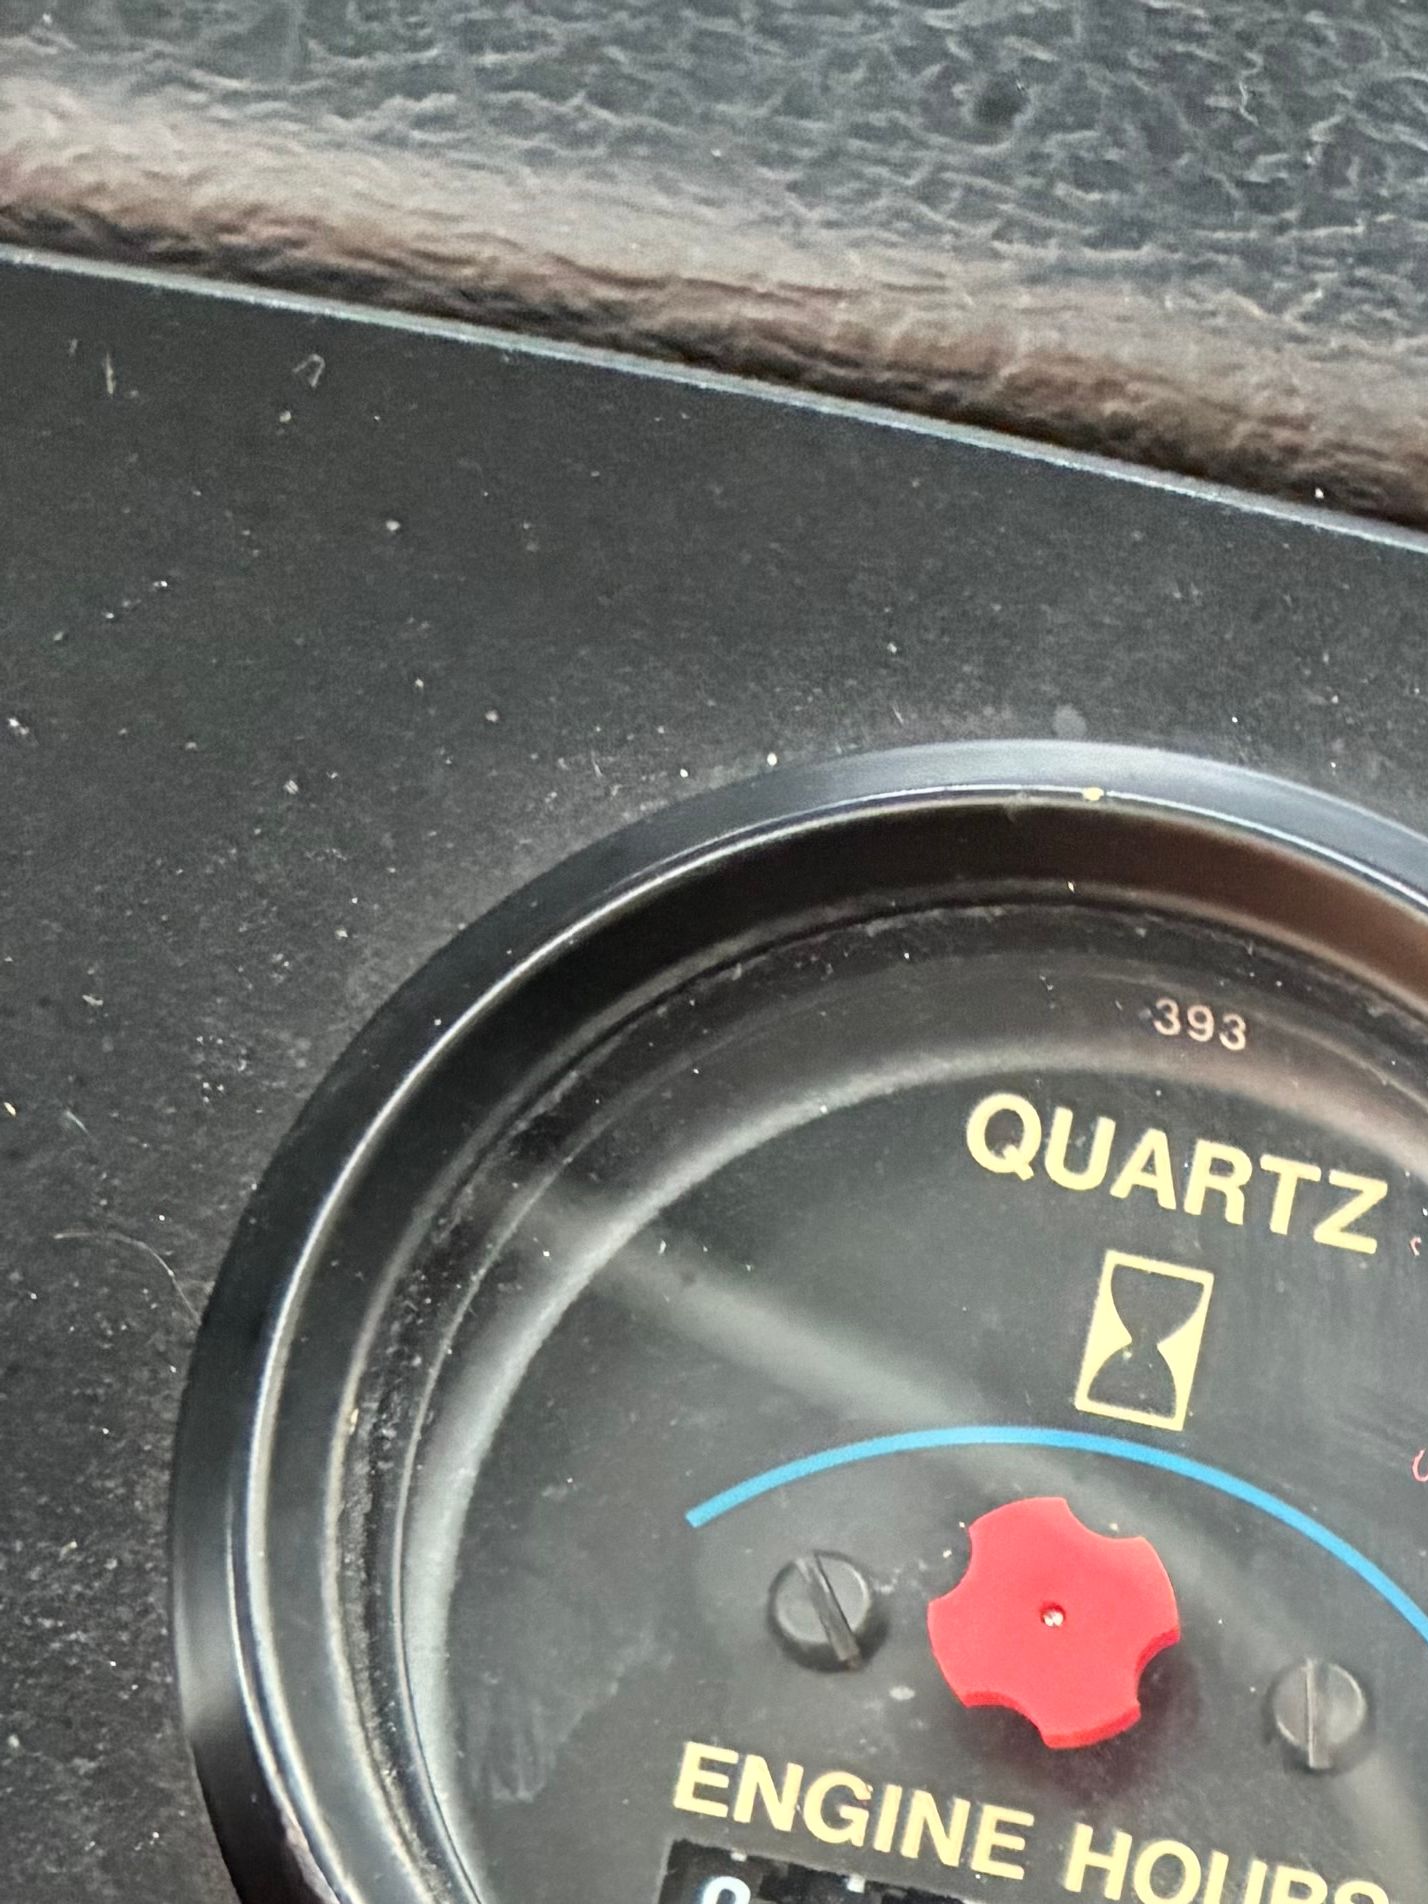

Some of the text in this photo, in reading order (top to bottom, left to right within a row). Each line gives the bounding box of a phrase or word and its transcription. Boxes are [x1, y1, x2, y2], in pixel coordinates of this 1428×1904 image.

[1153, 998, 1248, 1052] 393
[966, 1093, 1389, 1255] QUARTZ
[674, 1742, 1034, 1879] ENGINE
